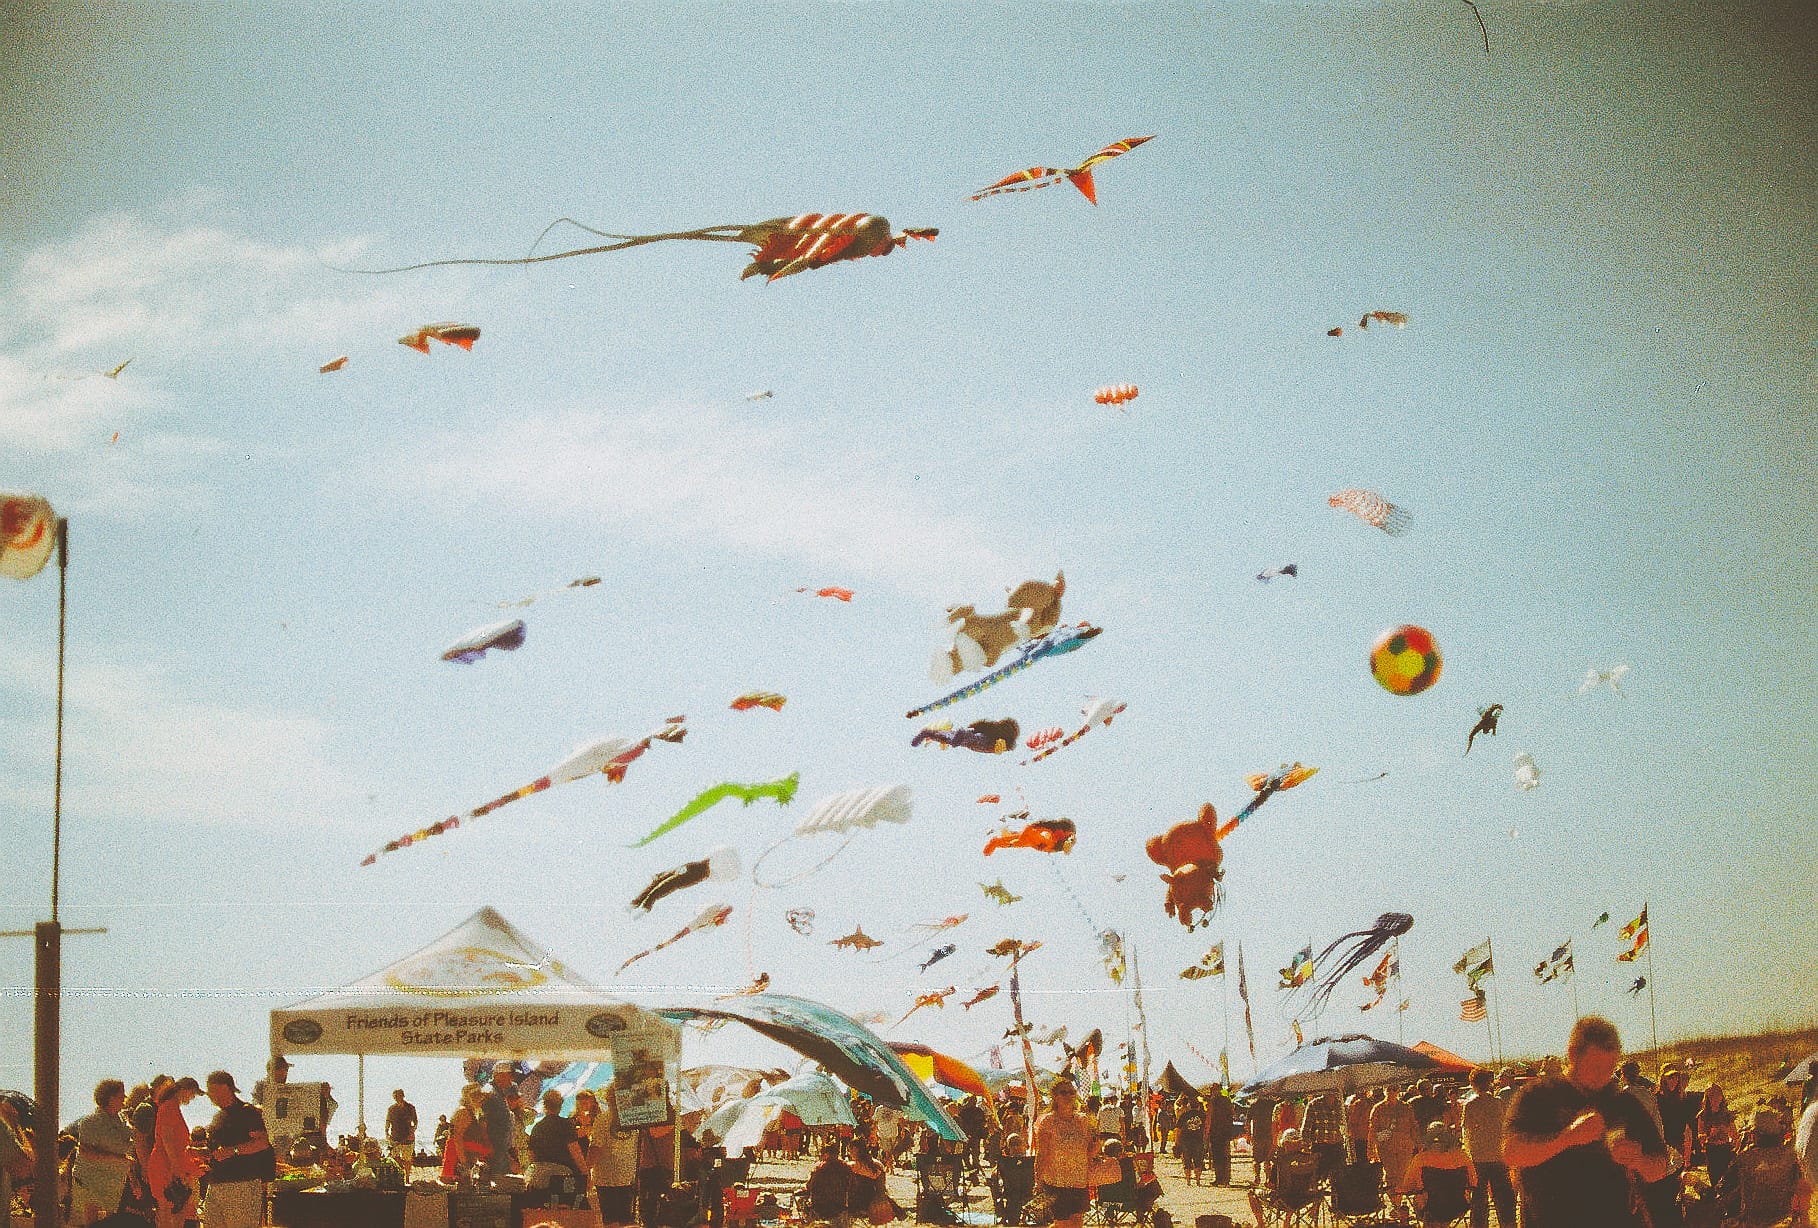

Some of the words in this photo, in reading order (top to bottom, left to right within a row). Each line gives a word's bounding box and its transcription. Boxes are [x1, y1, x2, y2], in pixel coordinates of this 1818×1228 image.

[346, 1013, 408, 1029] Friends
[413, 1013, 429, 1028] of
[434, 1011, 504, 1027] Pleasure
[509, 1011, 559, 1027] Island
[401, 1029, 453, 1044] State
[456, 1029, 504, 1044] Parks
